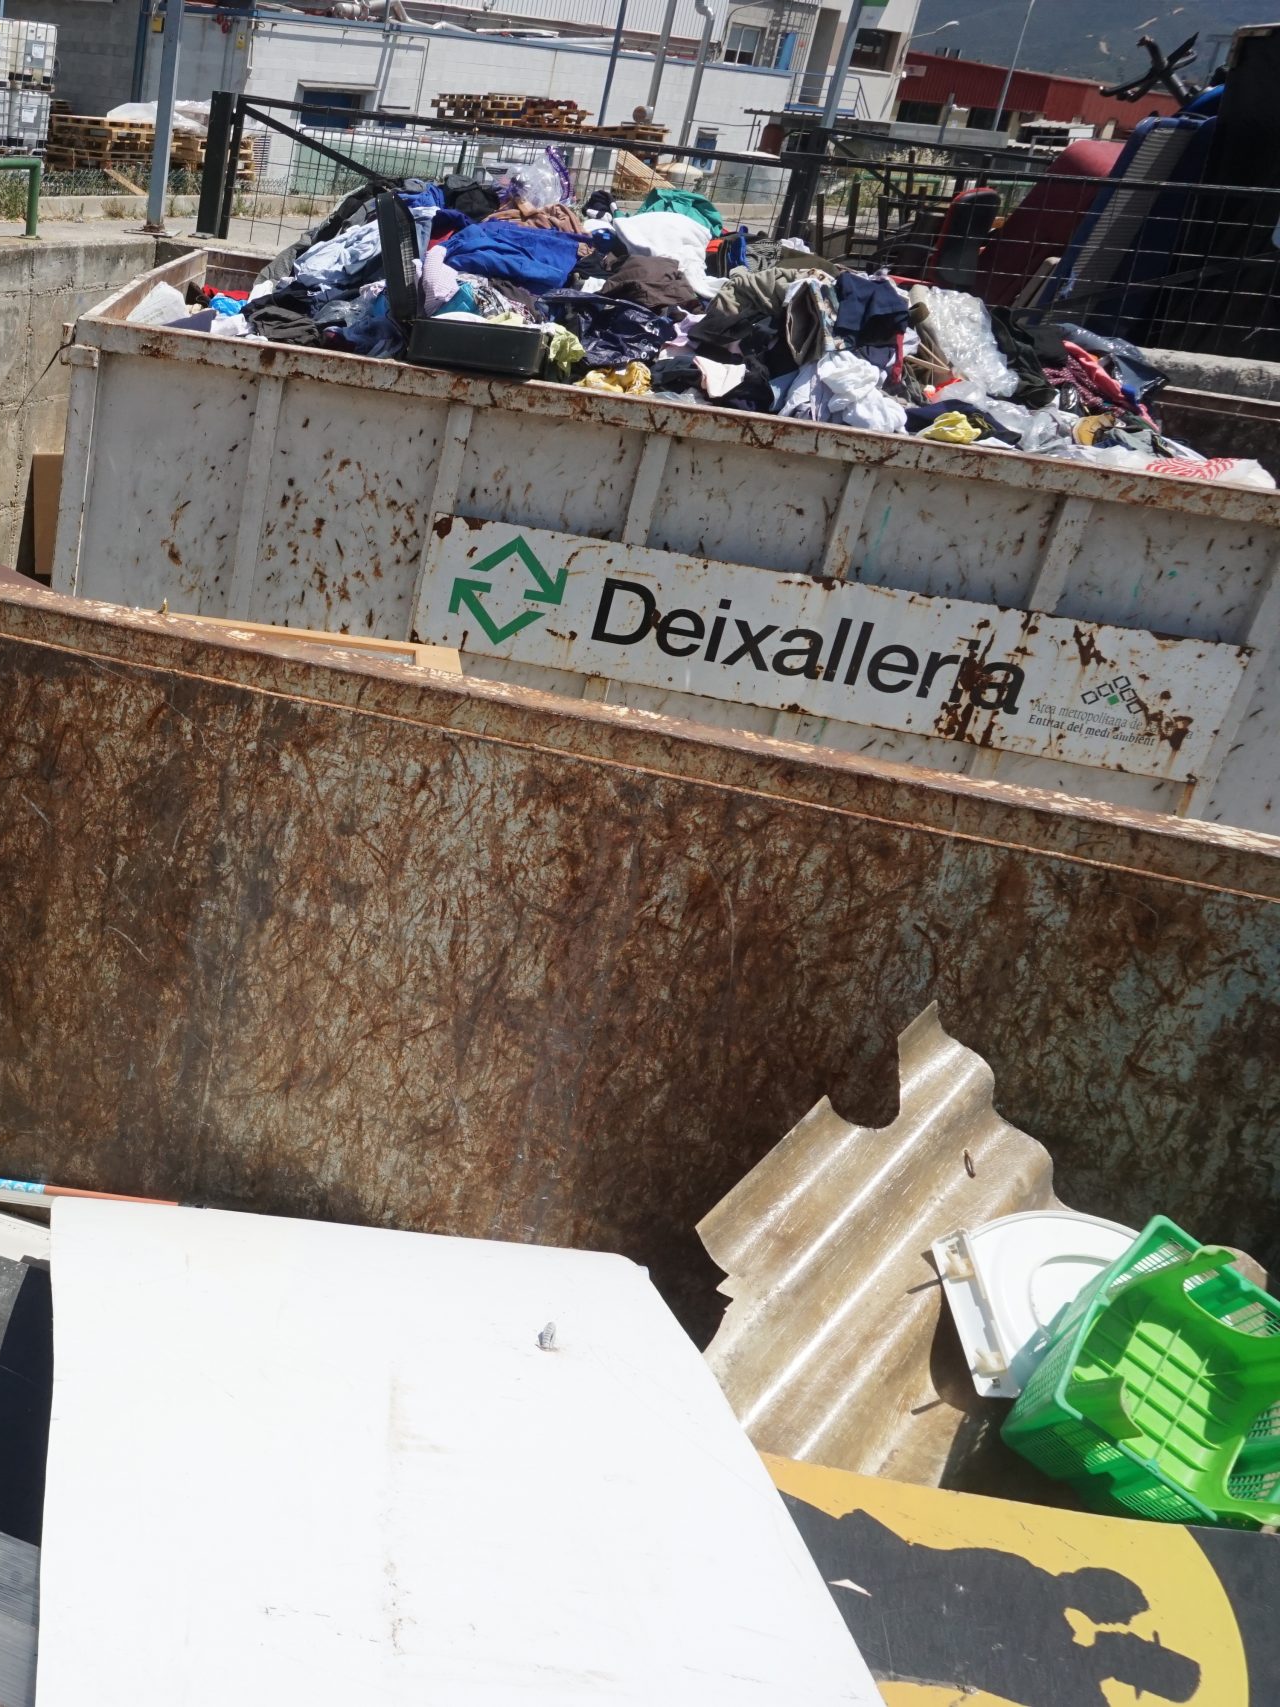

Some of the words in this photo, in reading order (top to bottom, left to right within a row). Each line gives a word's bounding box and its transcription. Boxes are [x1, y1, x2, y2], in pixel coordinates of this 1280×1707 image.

[591, 577, 1026, 715] Deixalleria
[1028, 714, 1066, 730] Entitat
[1067, 721, 1084, 734] del
[1085, 727, 1110, 739] medi
[1112, 731, 1155, 747] ambient
[1058, 706, 1127, 728] metropolitana
[1129, 716, 1143, 732] de
